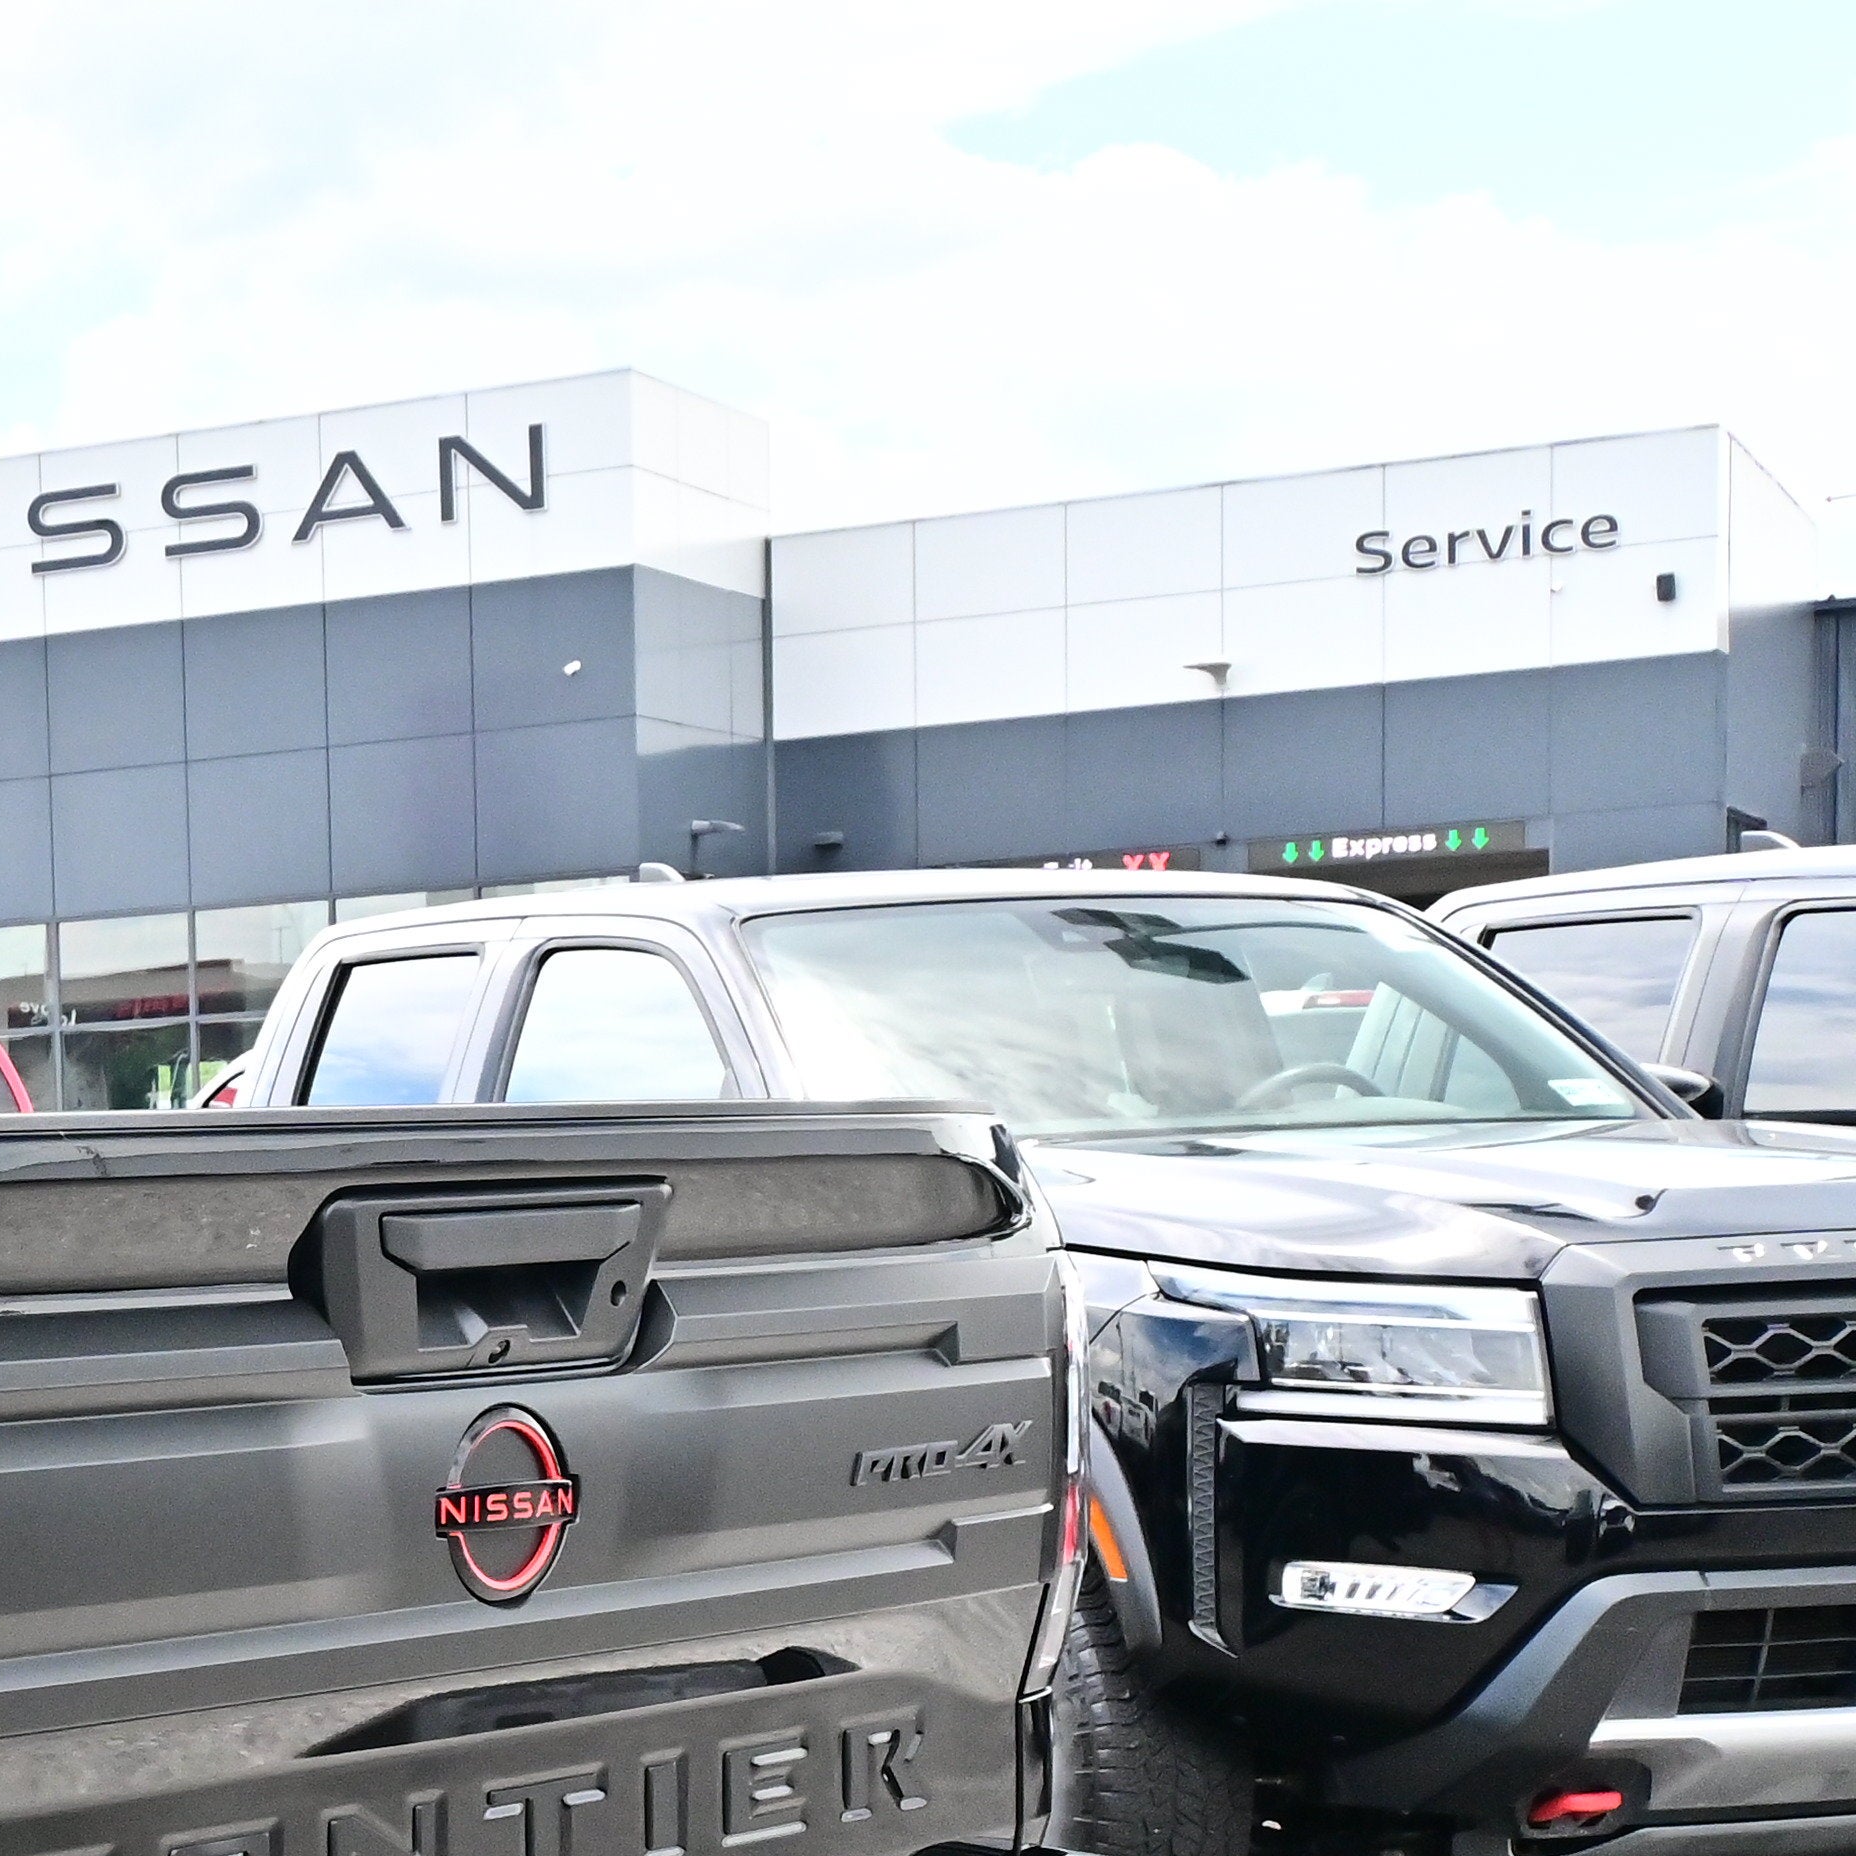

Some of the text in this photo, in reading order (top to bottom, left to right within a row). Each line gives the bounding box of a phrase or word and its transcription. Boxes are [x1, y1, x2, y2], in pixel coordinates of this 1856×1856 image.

[1355, 509, 1619, 575] Service
[1331, 833, 1437, 860] Express
[850, 1419, 1033, 1487] PRO-4X
[439, 1487, 574, 1526] NISSAN
